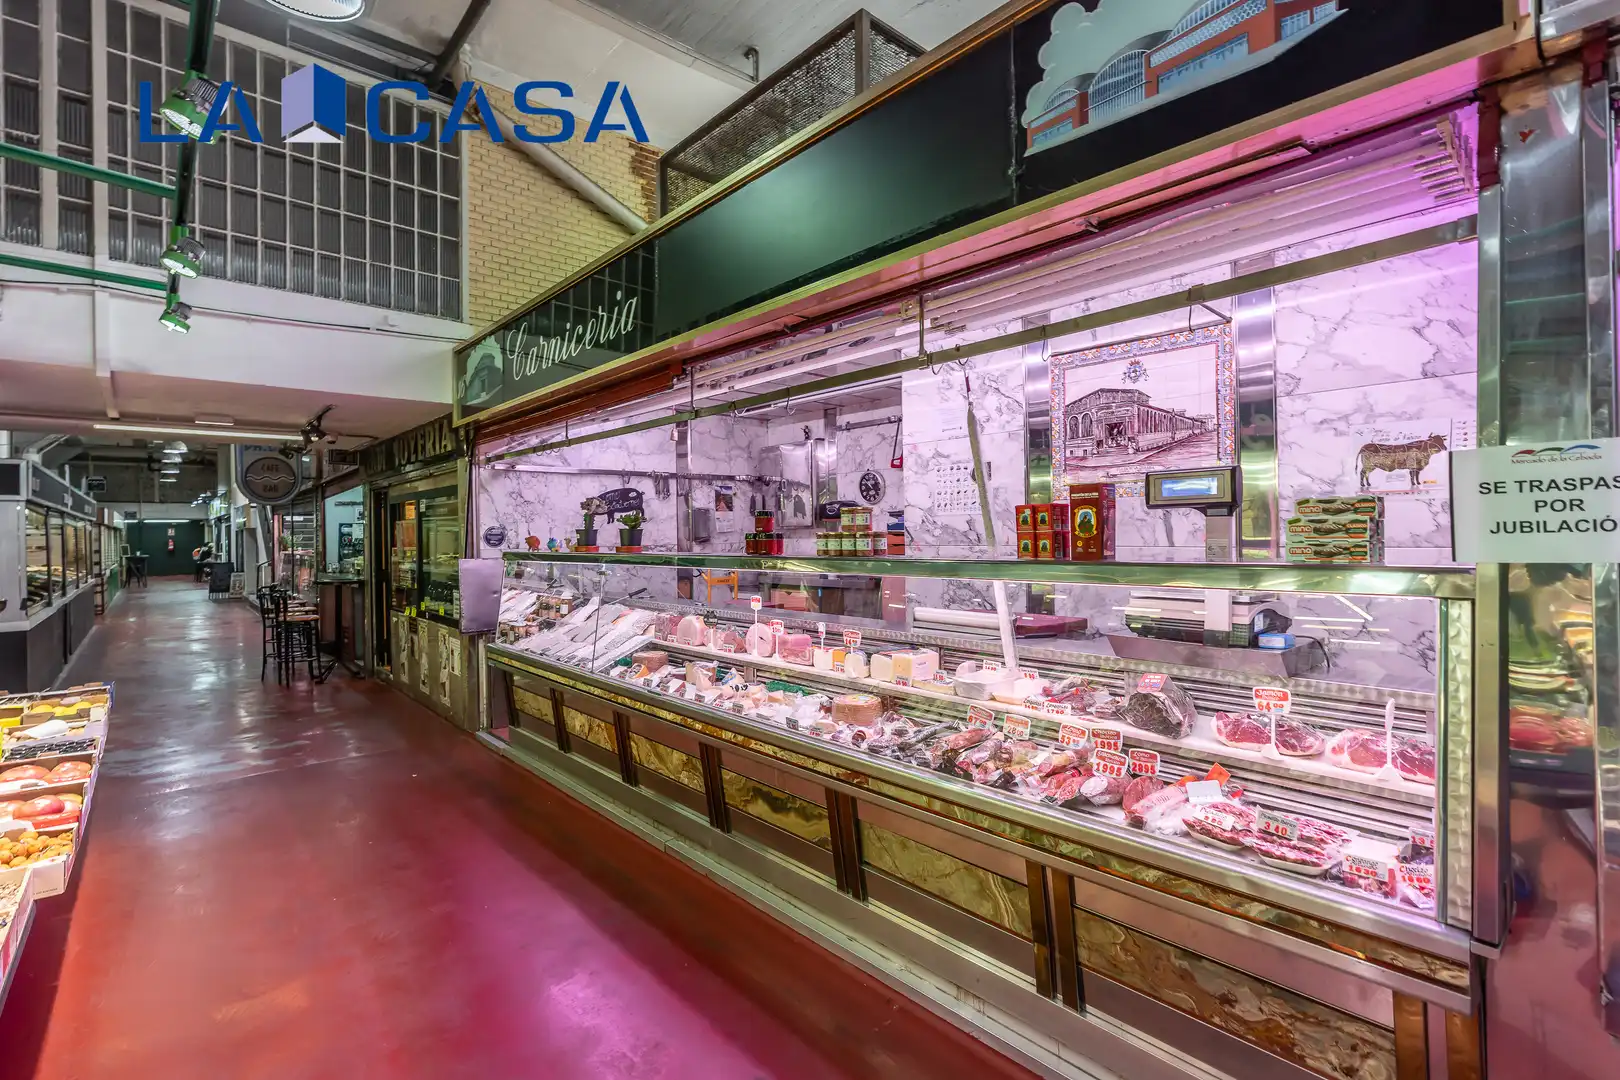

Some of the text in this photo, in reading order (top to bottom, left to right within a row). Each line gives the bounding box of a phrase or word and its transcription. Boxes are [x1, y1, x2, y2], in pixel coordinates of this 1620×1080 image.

[507, 291, 637, 381] Carniceria
[1478, 481, 1507, 495] SE
[1534, 498, 1586, 513] POR
[1490, 515, 1618, 534] JUBILACIÓ
